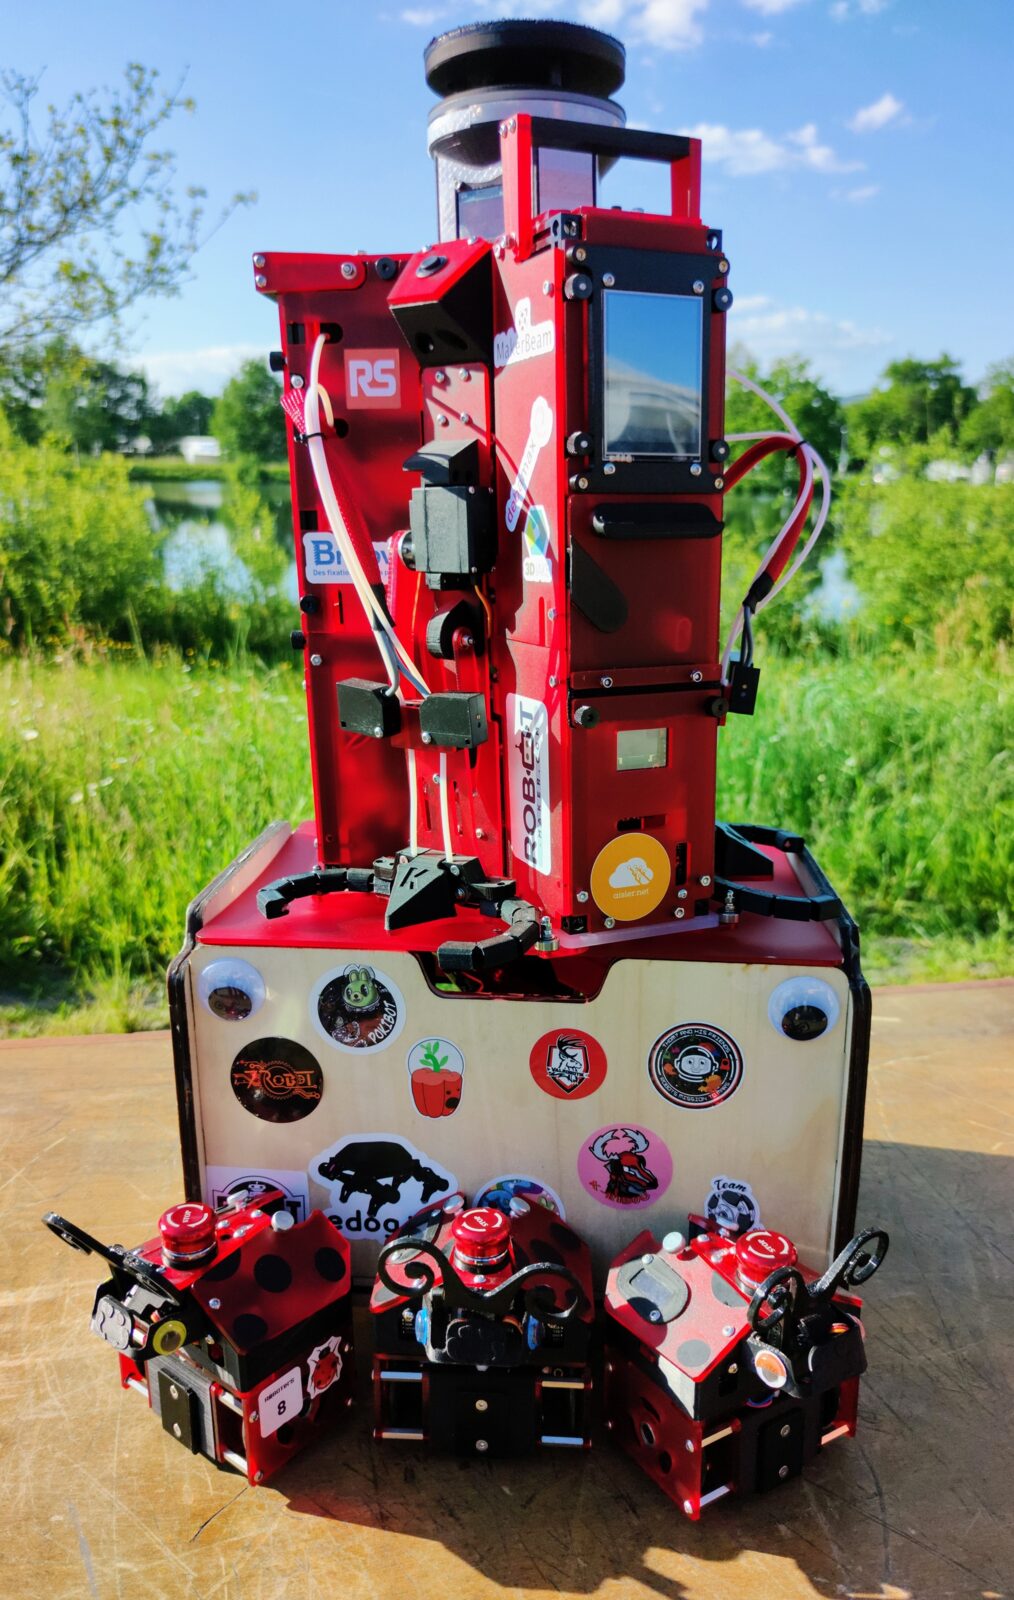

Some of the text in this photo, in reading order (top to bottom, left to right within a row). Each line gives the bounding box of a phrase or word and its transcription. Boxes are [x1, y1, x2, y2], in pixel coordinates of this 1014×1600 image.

[349, 360, 397, 397] RS
[327, 568, 350, 576] fixatio
[613, 888, 650, 899] aisler.net
[713, 1179, 747, 1192] Team
[182, 1210, 192, 1223] STOP
[473, 1215, 489, 1227] STOP
[757, 1239, 776, 1253] STOP
[277, 1400, 287, 1416] 8
